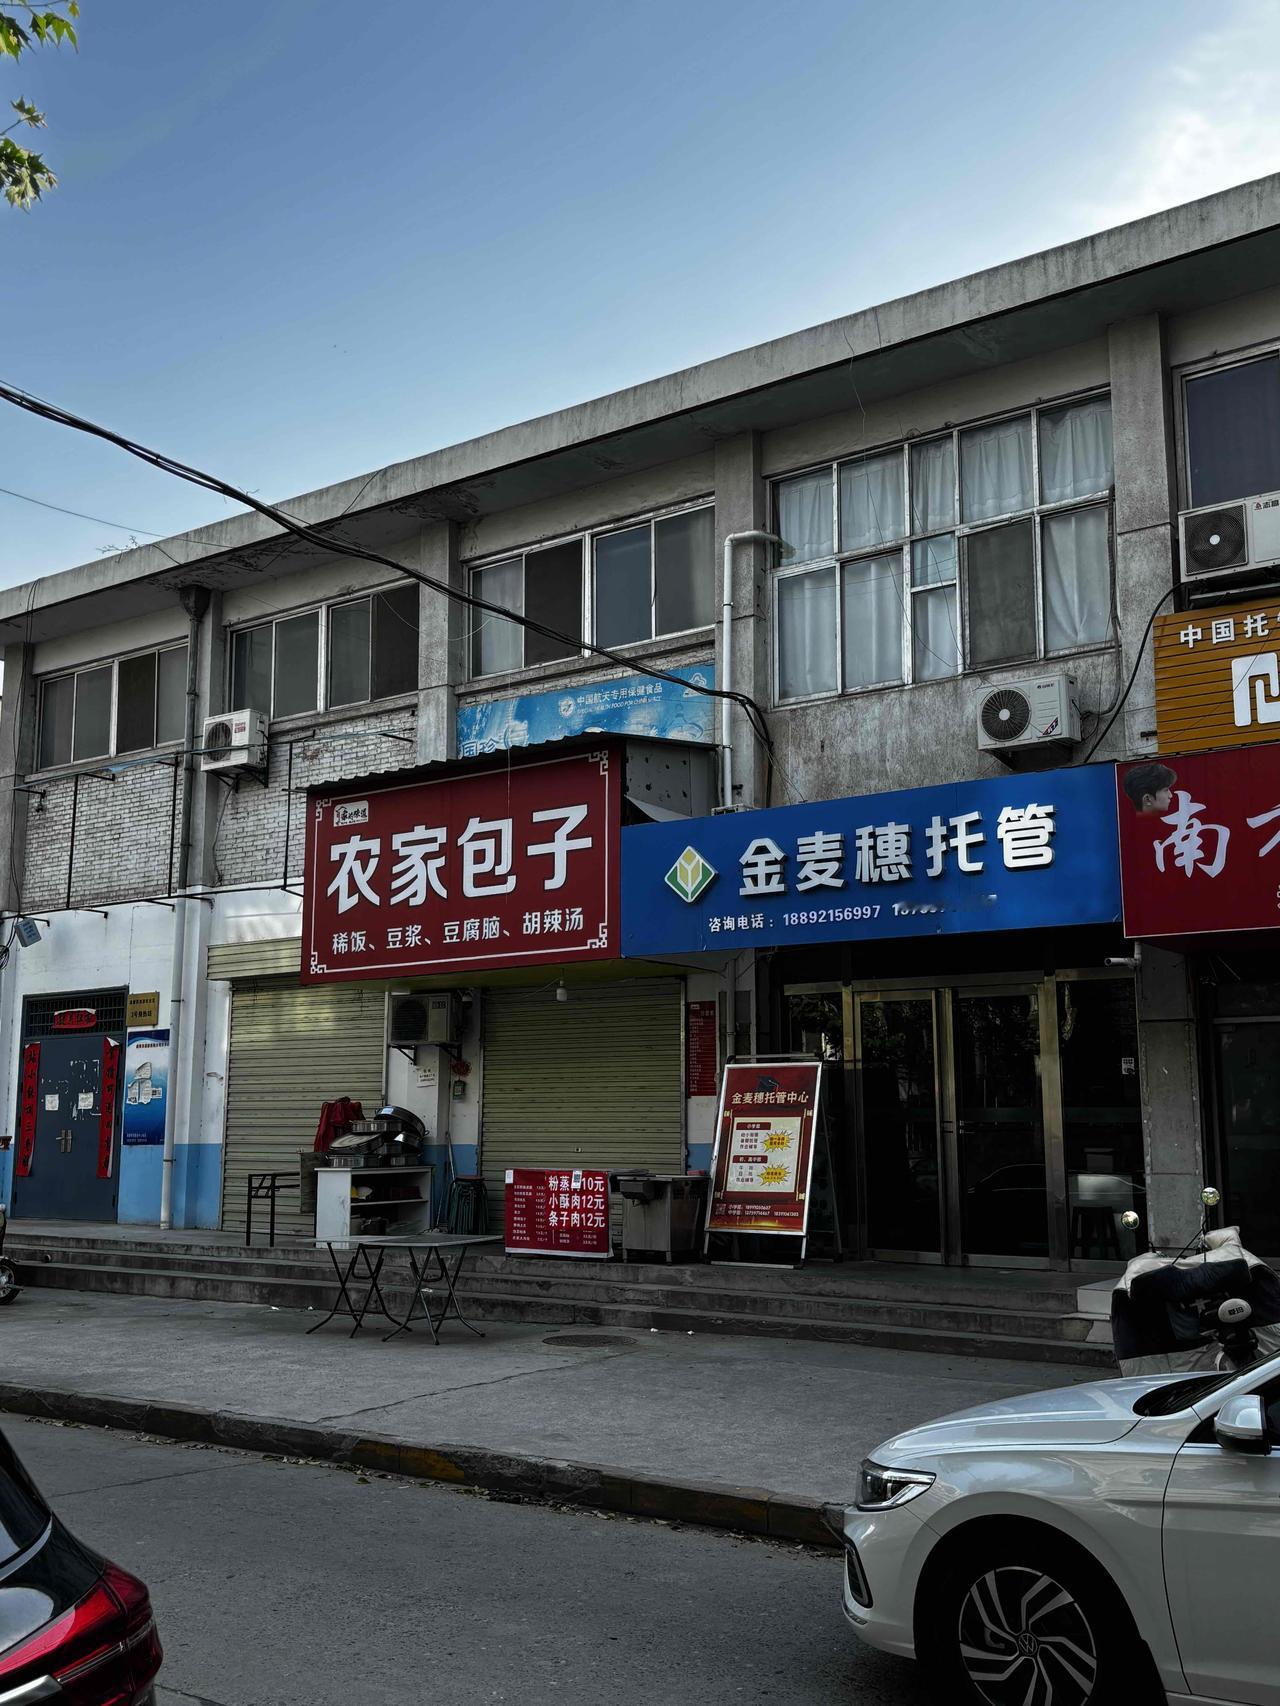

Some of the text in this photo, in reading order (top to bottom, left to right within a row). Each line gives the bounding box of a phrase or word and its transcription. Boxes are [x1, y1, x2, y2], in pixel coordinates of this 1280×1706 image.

[1180, 613, 1280, 648] 中国托
[576, 682, 663, 706] 中国航天专用保健食品
[327, 804, 593, 914] 农家包子
[739, 802, 1056, 897] 金麦穗托管
[783, 905, 881, 926] 18892156997
[731, 1091, 809, 1104] 金麦穗托管中心
[548, 1176, 605, 1192] 粉蒸10元
[548, 1192, 605, 1210] 小酥肉12元
[548, 1210, 606, 1228] 条子肉12元
